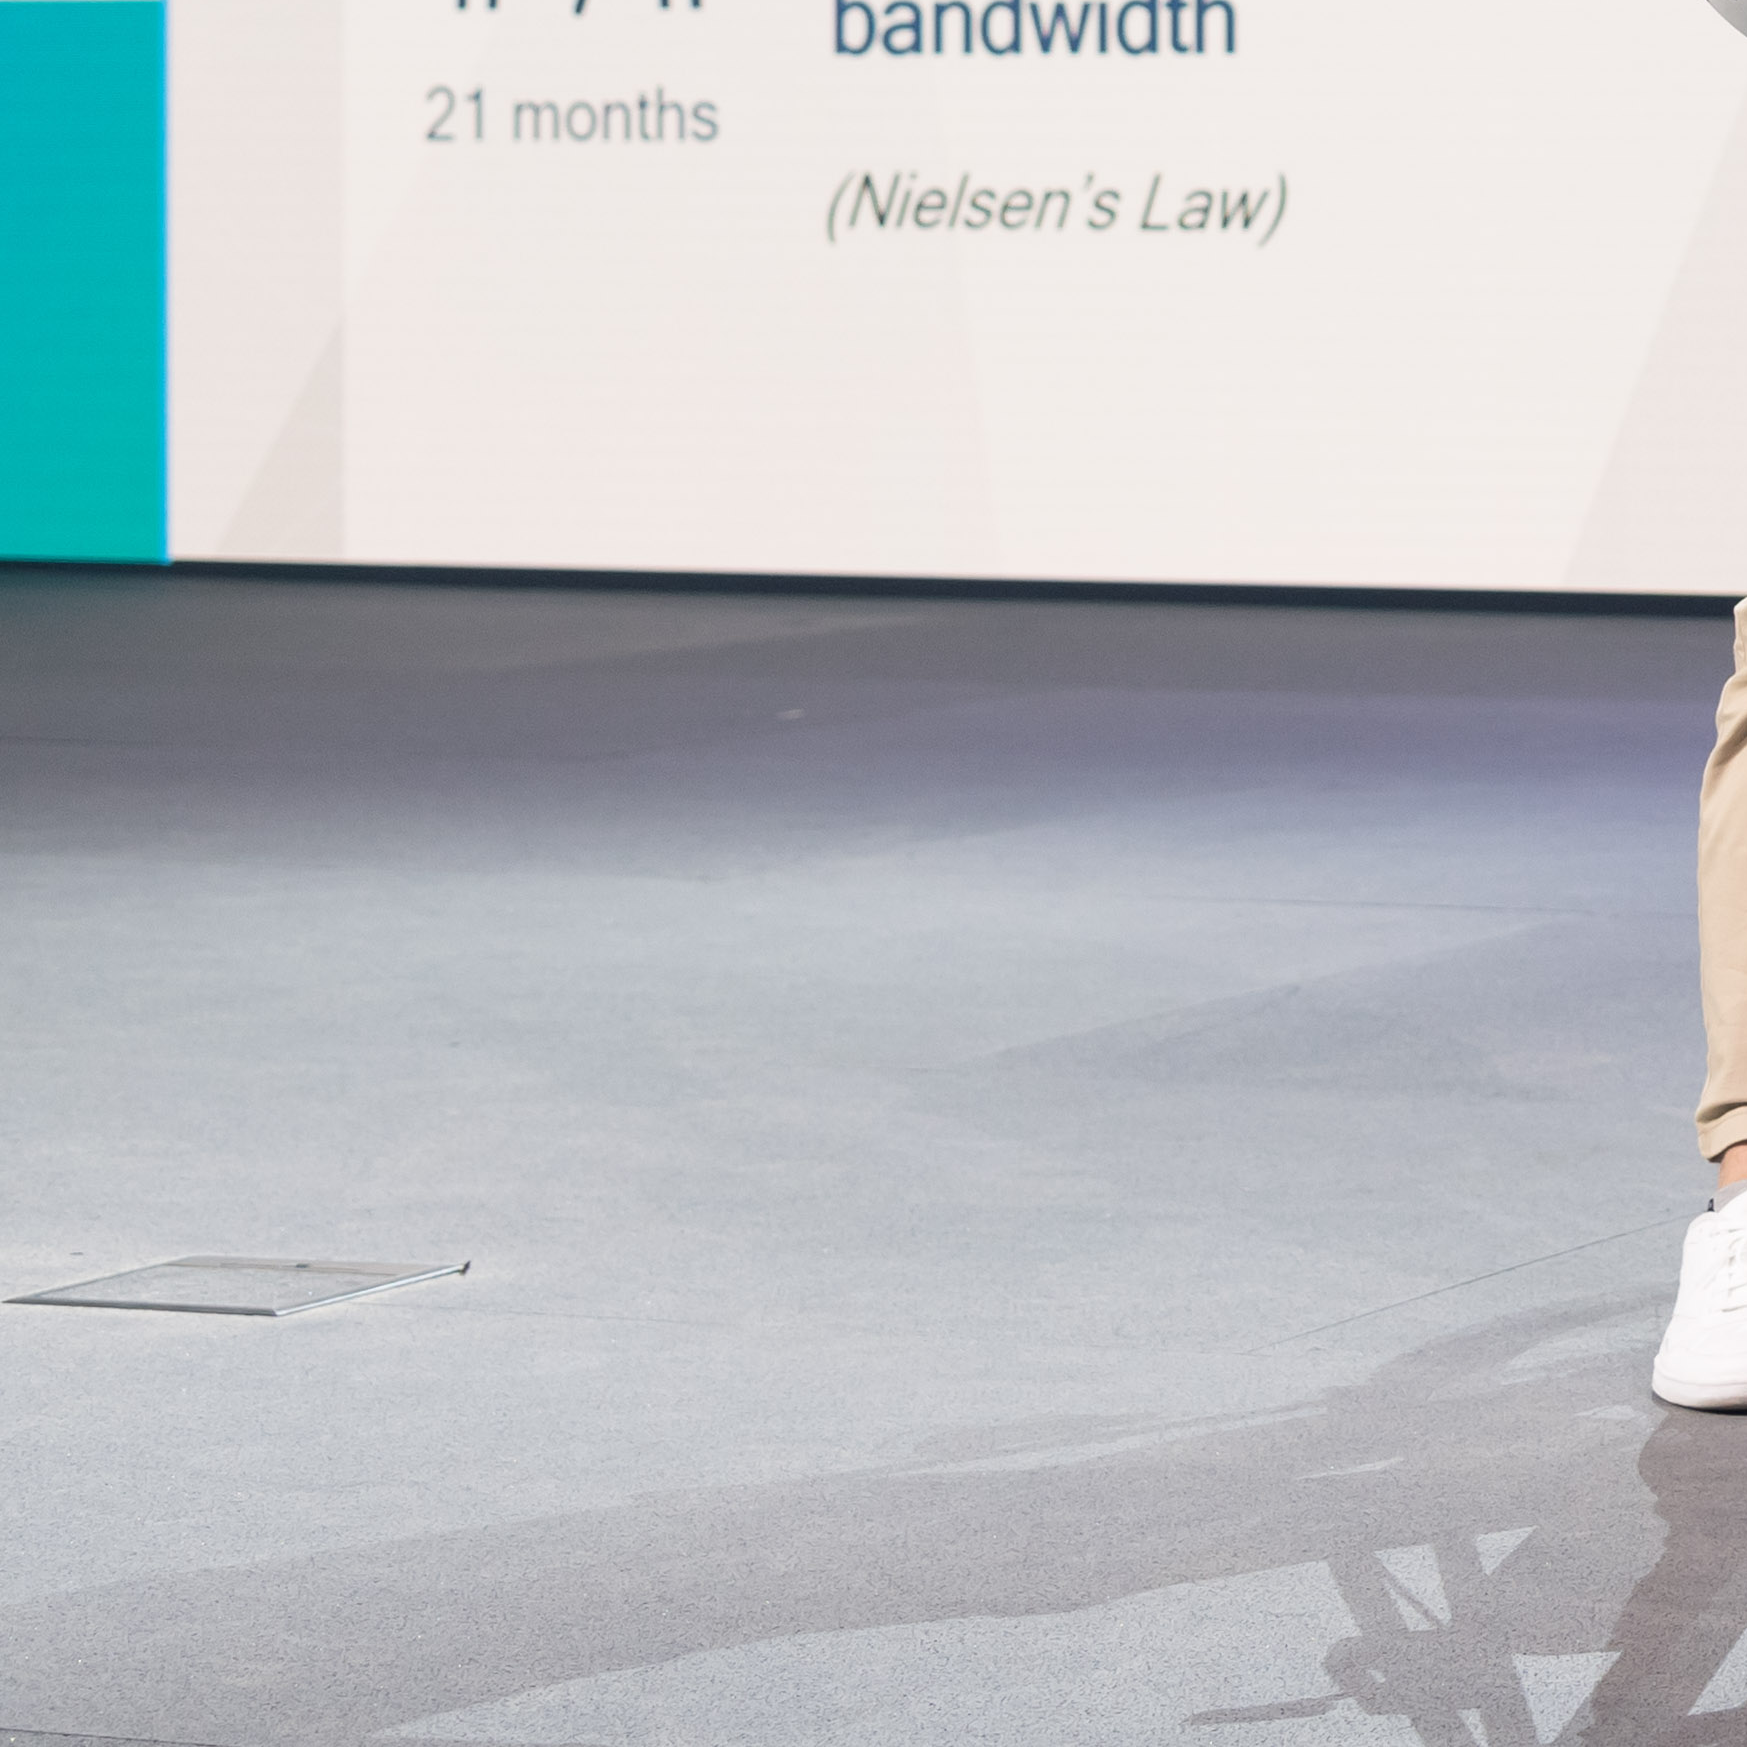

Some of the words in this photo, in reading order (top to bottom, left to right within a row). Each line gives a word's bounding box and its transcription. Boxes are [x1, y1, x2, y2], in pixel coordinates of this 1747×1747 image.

[425, 85, 484, 143] 21
[512, 86, 720, 143] months
[1139, 173, 1290, 245] Law)
